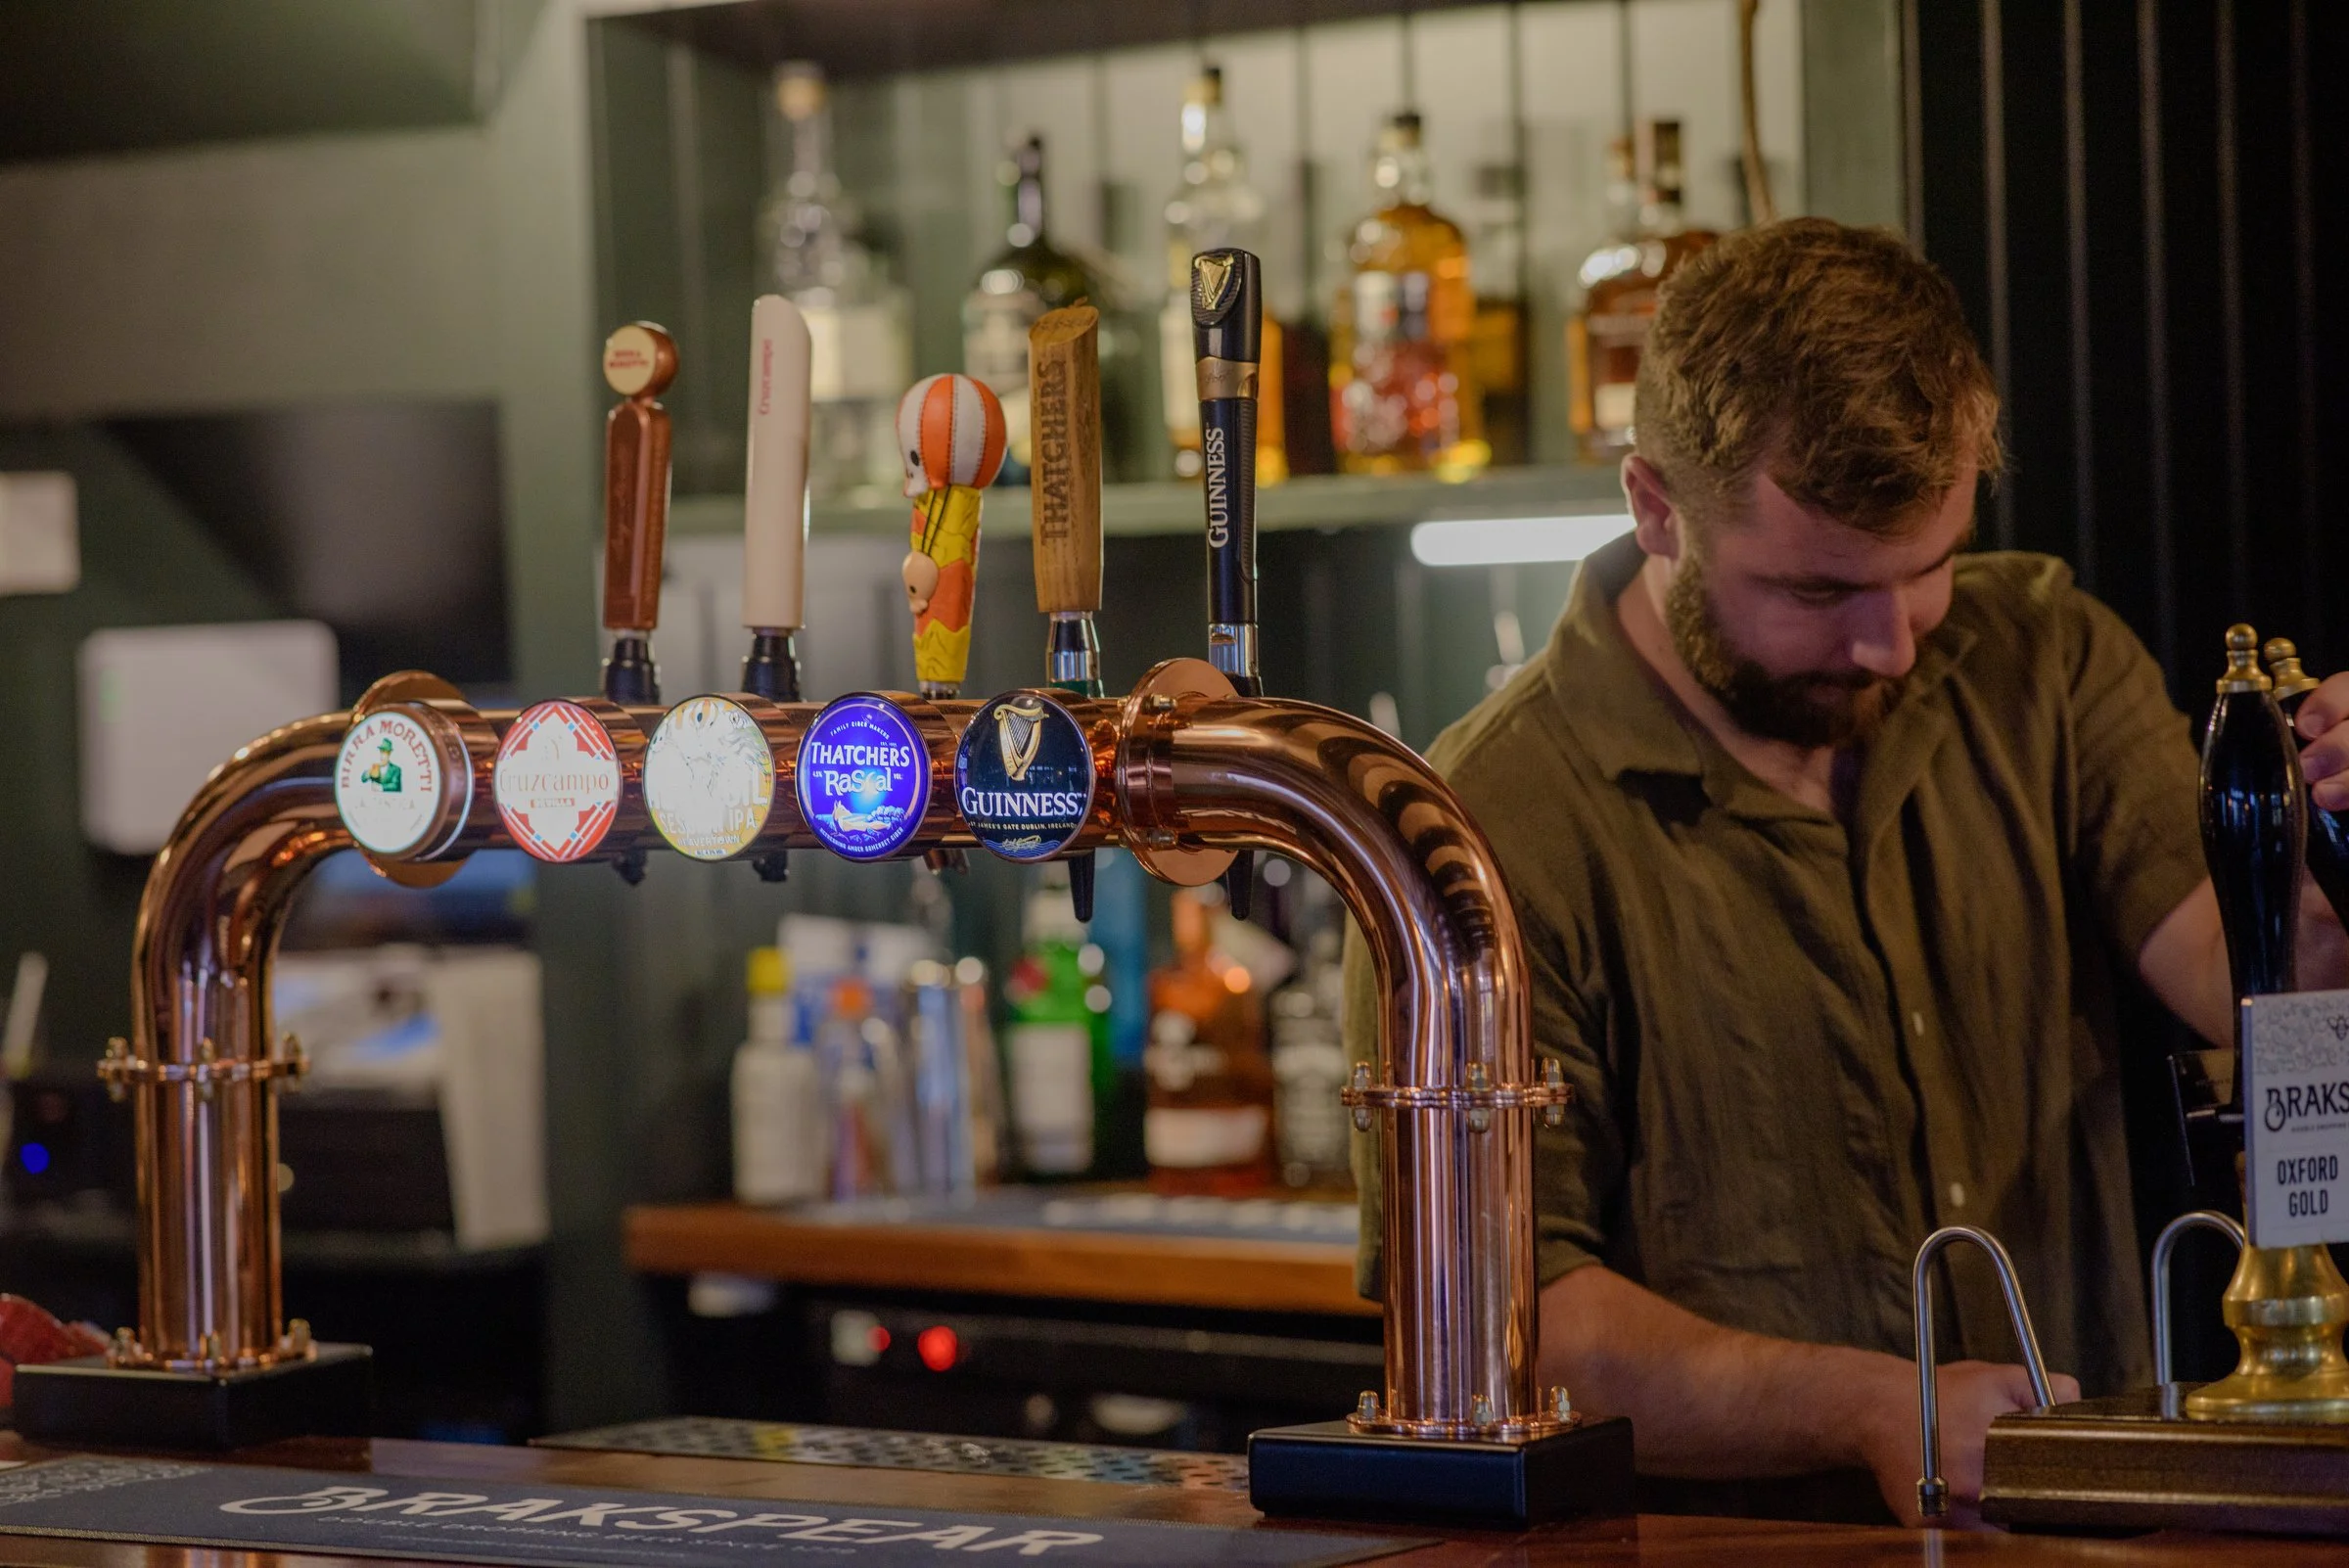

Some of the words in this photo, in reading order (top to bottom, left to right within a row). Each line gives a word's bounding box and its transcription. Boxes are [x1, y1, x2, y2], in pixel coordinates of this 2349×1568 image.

[1037, 360, 1069, 545] THATCHERS
[1206, 427, 1230, 549] GUINNESS
[342, 725, 375, 789] BIRRA
[379, 719, 433, 793] MORETTI
[810, 741, 910, 768] THATCHERS
[499, 769, 609, 795] Cruzcampo
[961, 786, 1079, 818] GUINNESS
[729, 807, 759, 832] IPA
[2278, 1155, 2338, 1185] OXFORD
[2288, 1189, 2329, 1218] GOLD
[219, 1486, 1104, 1555] BRAKSPEAR
